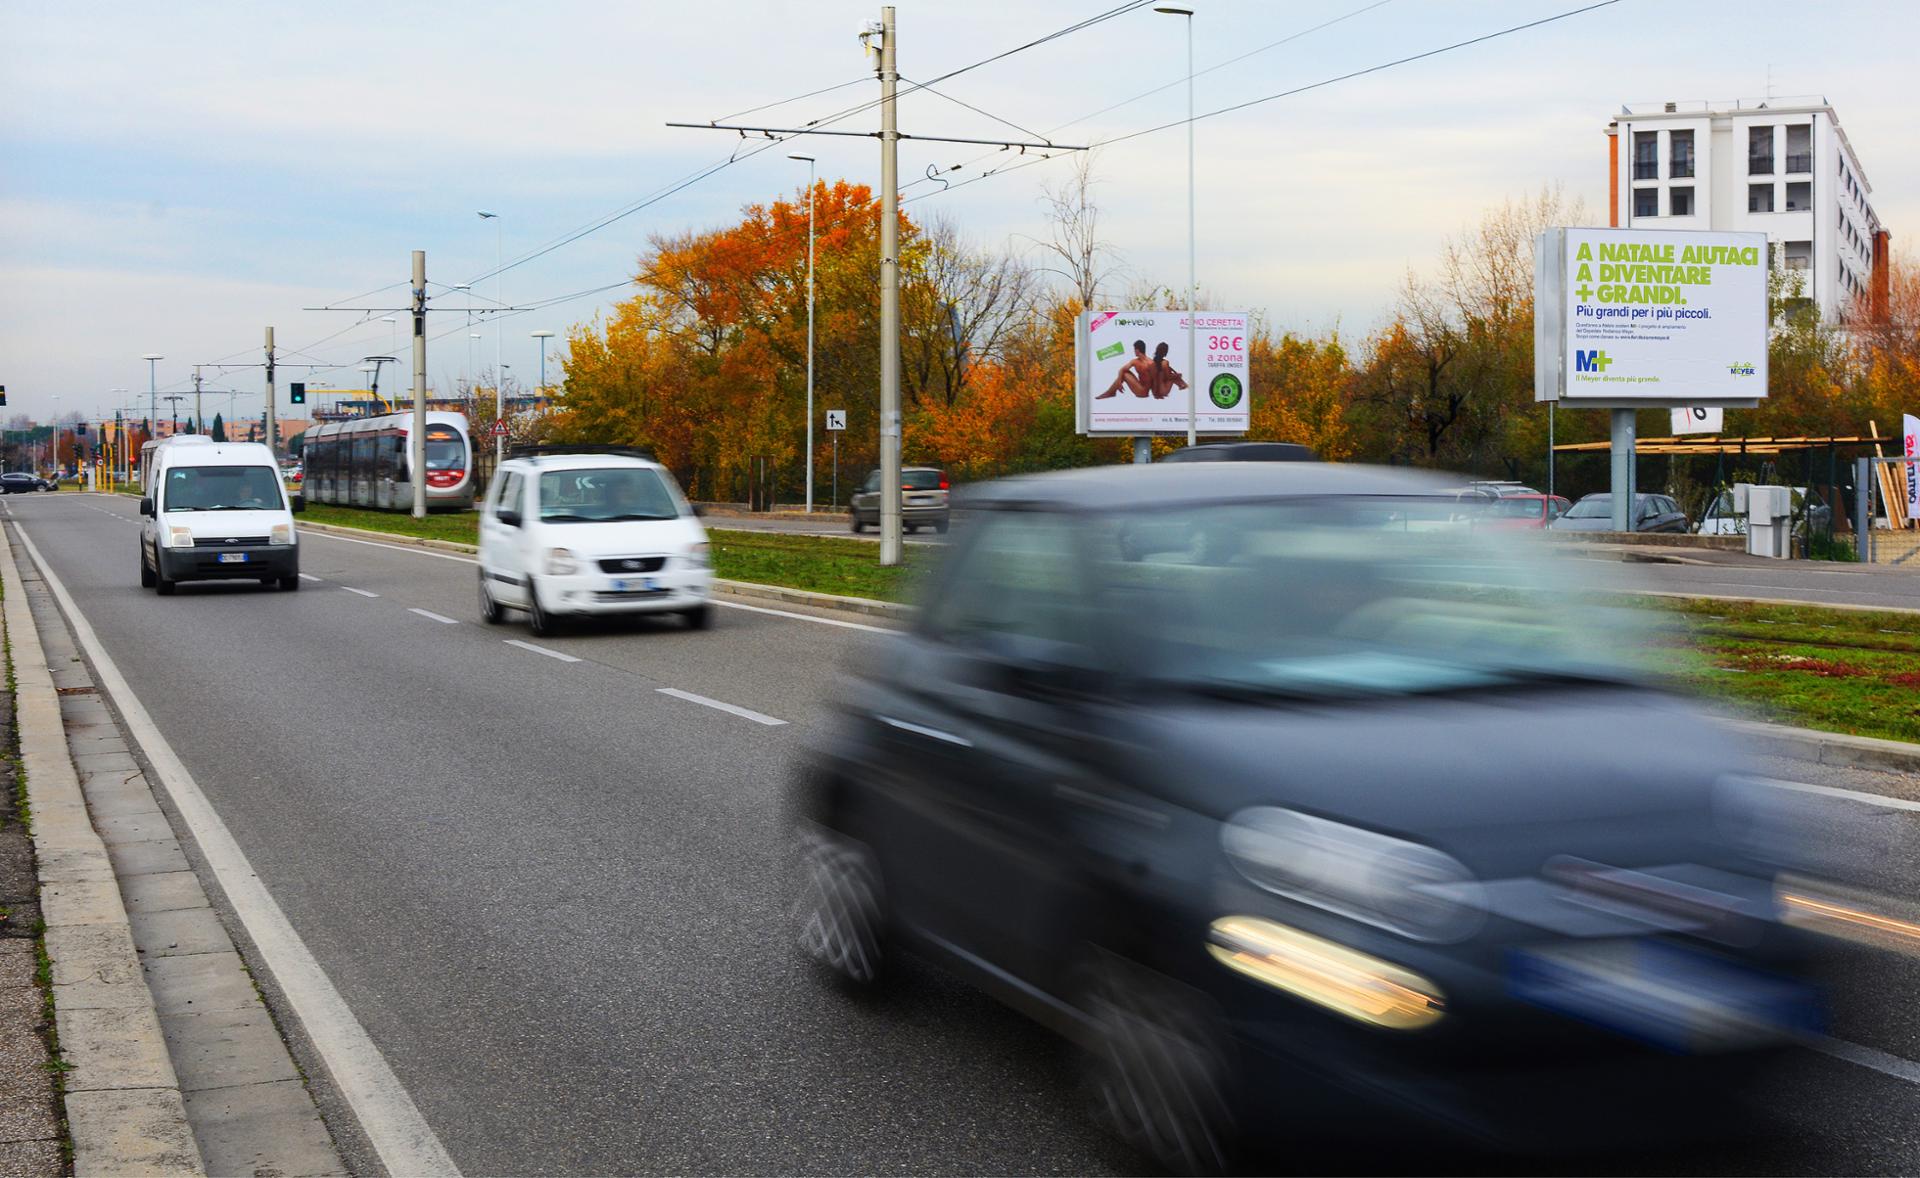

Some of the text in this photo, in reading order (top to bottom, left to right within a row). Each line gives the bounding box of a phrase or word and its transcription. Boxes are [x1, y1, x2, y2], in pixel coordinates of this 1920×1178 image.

[1576, 242, 1759, 266] A NATALE AIUTACI
[1576, 263, 1711, 285] A DIVENTARE
[1576, 305, 1593, 317] Più
[1596, 306, 1629, 320] grandi
[1631, 308, 1649, 320] per
[1656, 307, 1673, 320] più
[1675, 307, 1712, 320] piccoli.
[1217, 354, 1243, 362] zona
[1575, 350, 1612, 372] M+
